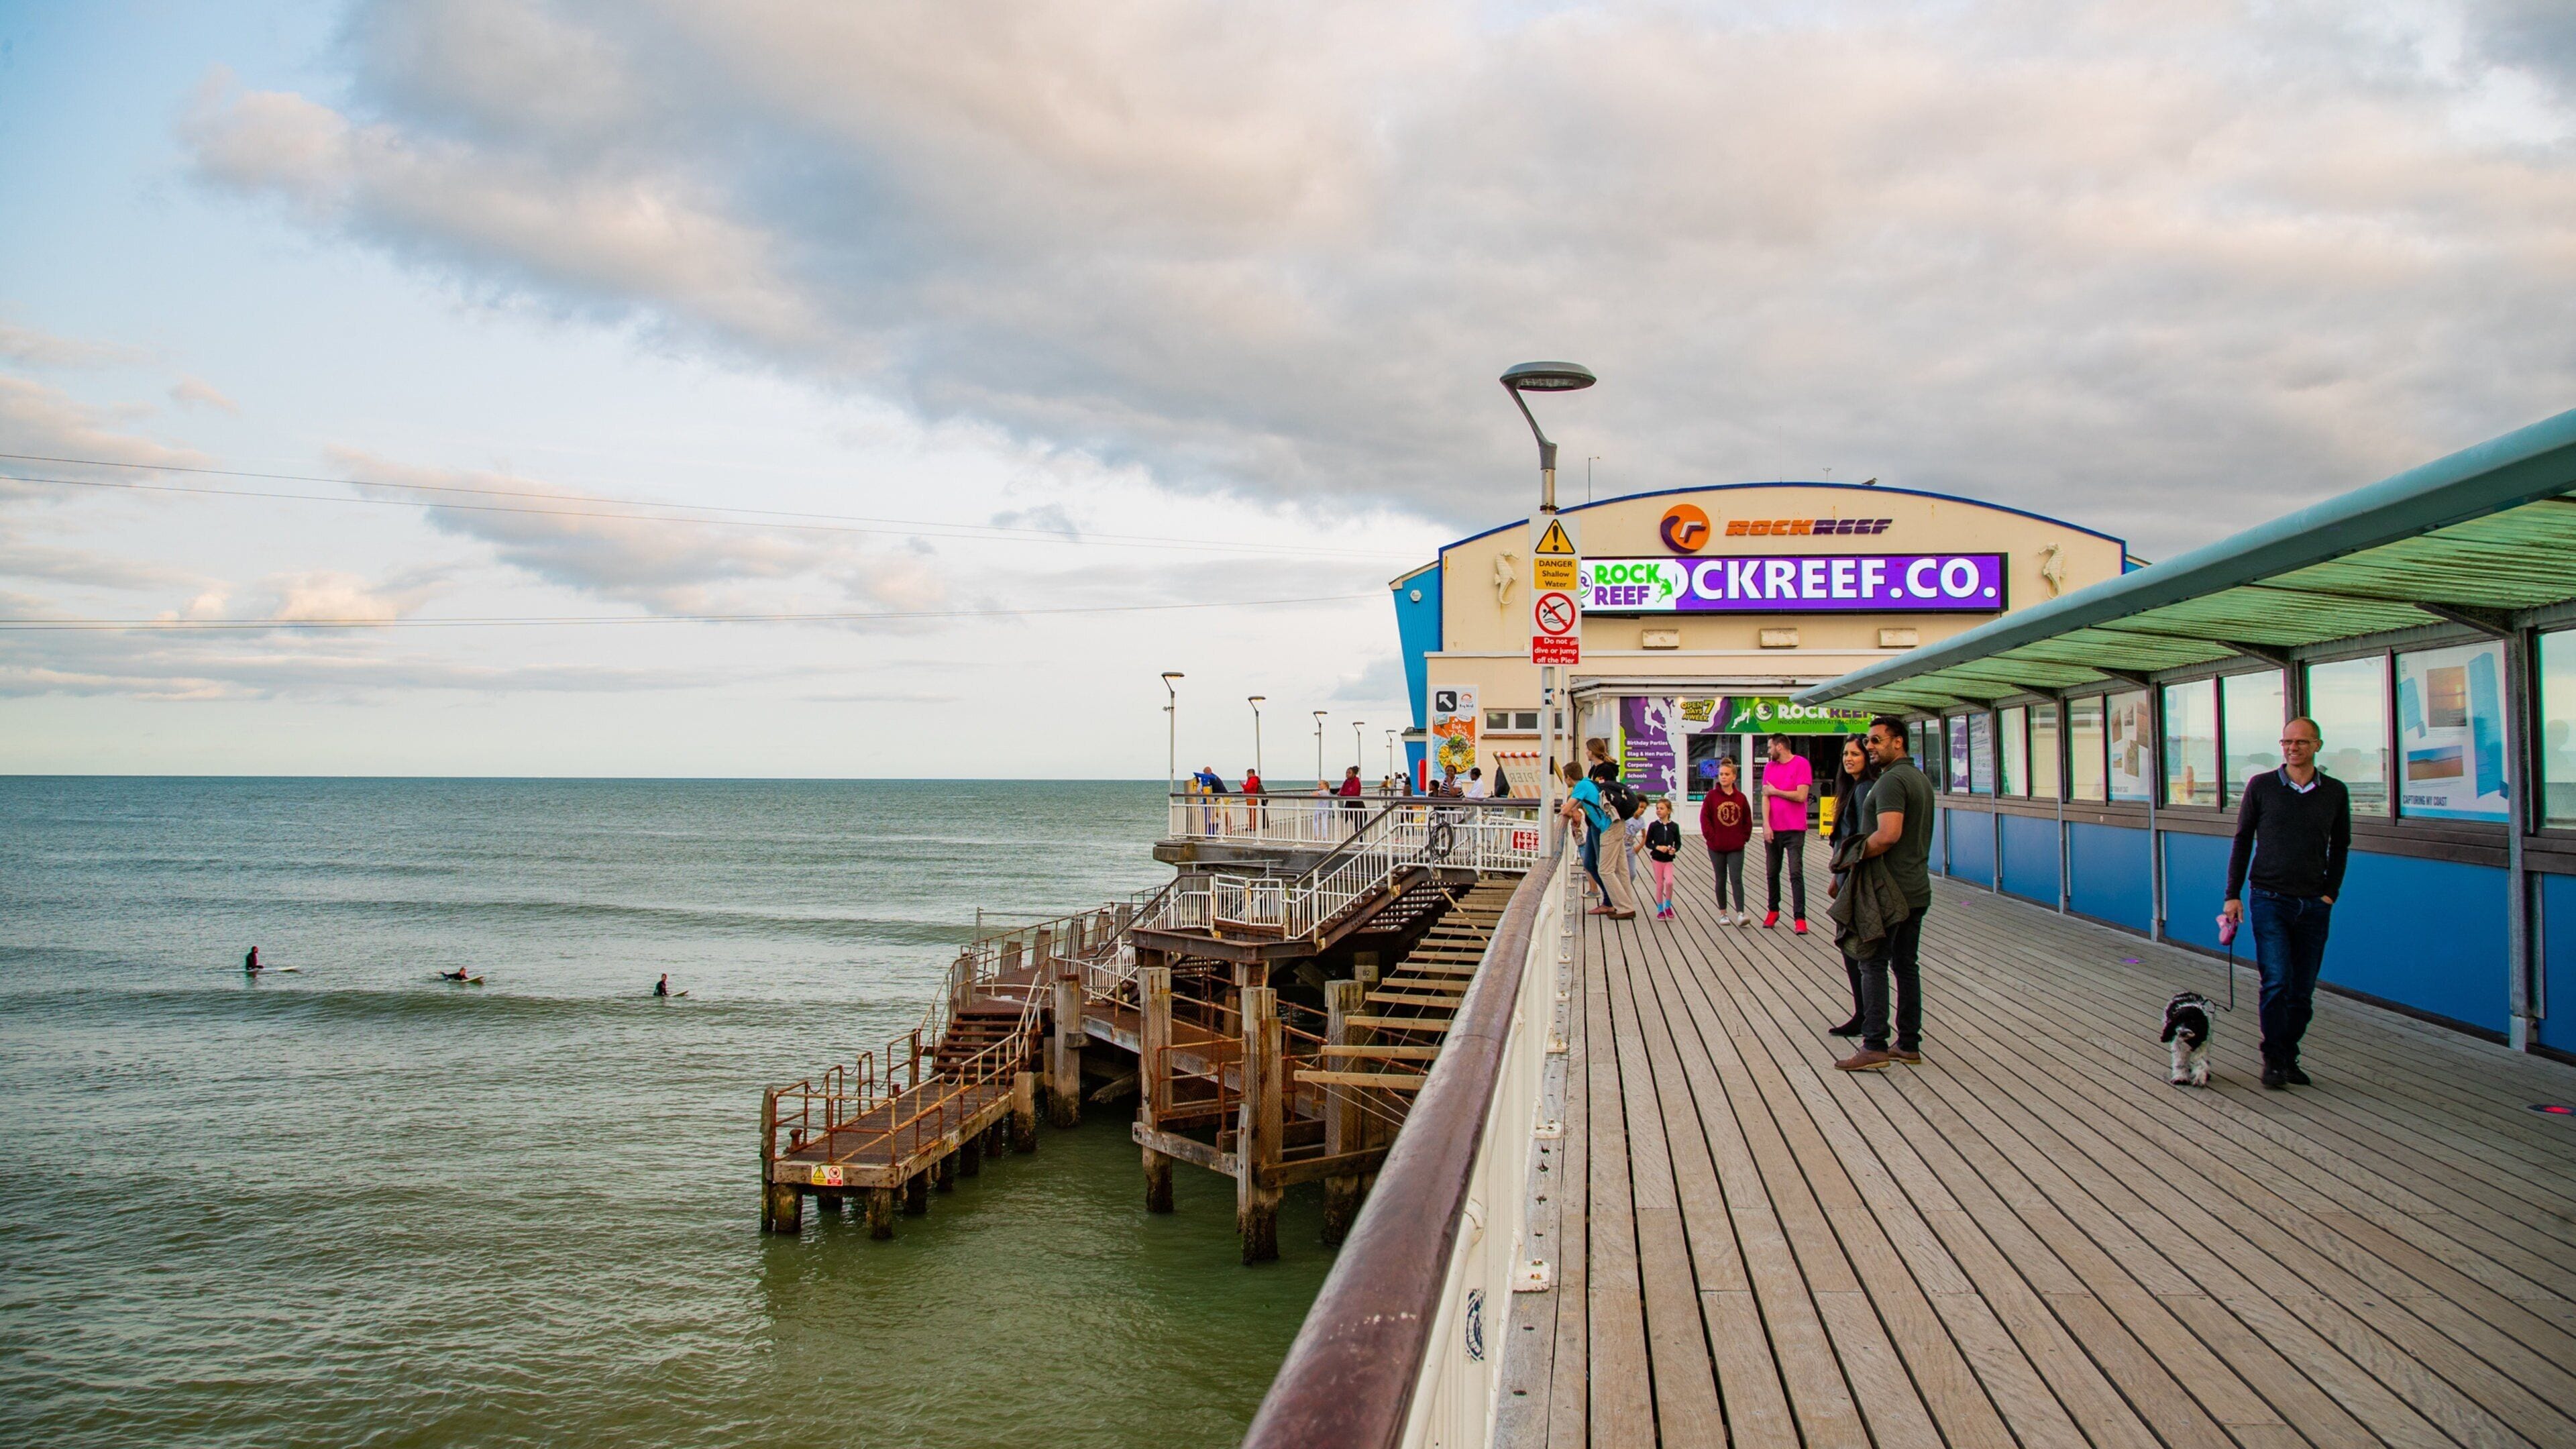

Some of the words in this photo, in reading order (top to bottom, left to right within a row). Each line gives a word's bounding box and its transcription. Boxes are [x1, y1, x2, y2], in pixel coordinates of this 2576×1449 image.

[1725, 519, 1892, 536] ROCKREEF
[1595, 564, 1660, 585] ROCK
[1595, 586, 1650, 605] REEF
[1559, 647, 1577, 656] jump
[1680, 701, 1704, 709] OPEN
[1704, 700, 1715, 715] 7
[2403, 794, 2426, 806] CAPTURING
[2433, 796, 2448, 806] COAST
